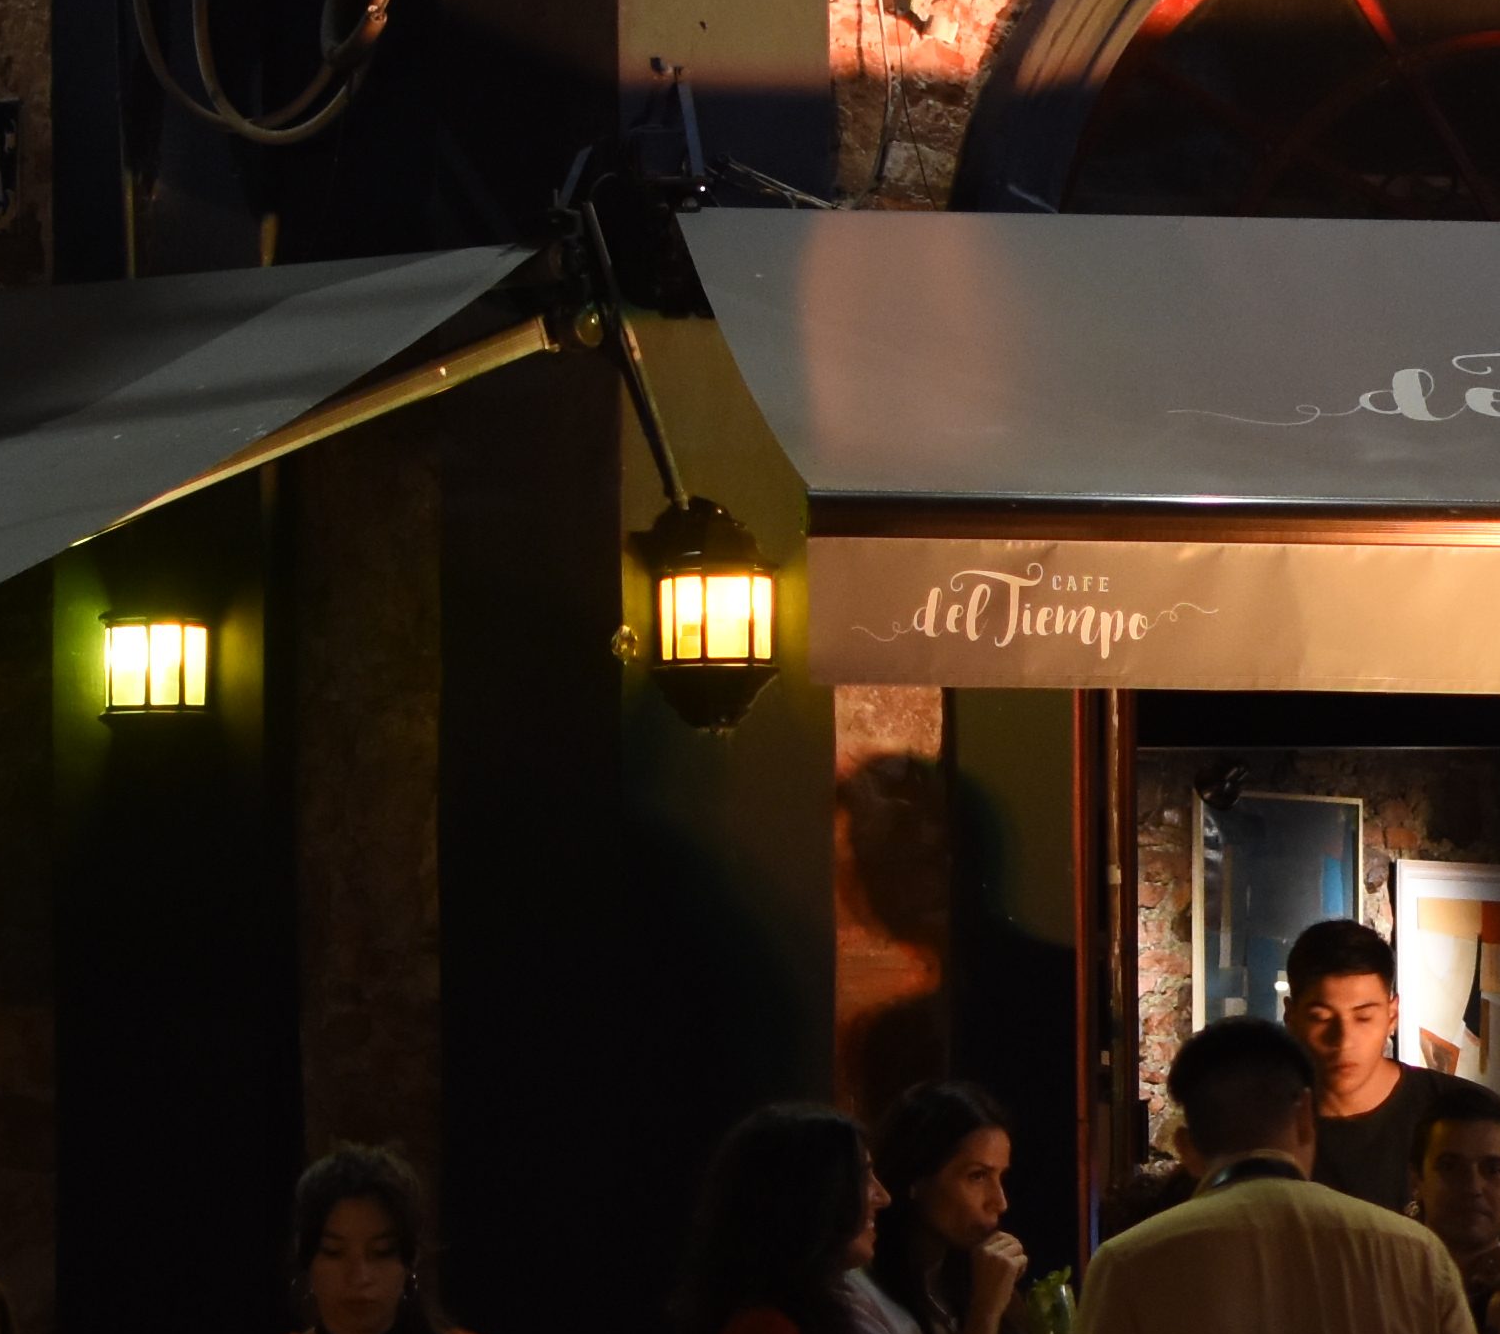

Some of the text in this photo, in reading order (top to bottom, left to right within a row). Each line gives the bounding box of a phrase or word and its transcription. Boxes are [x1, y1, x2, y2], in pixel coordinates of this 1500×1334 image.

[913, 562, 1150, 660] del Tiempo
[1052, 574, 1110, 593] CAFE
